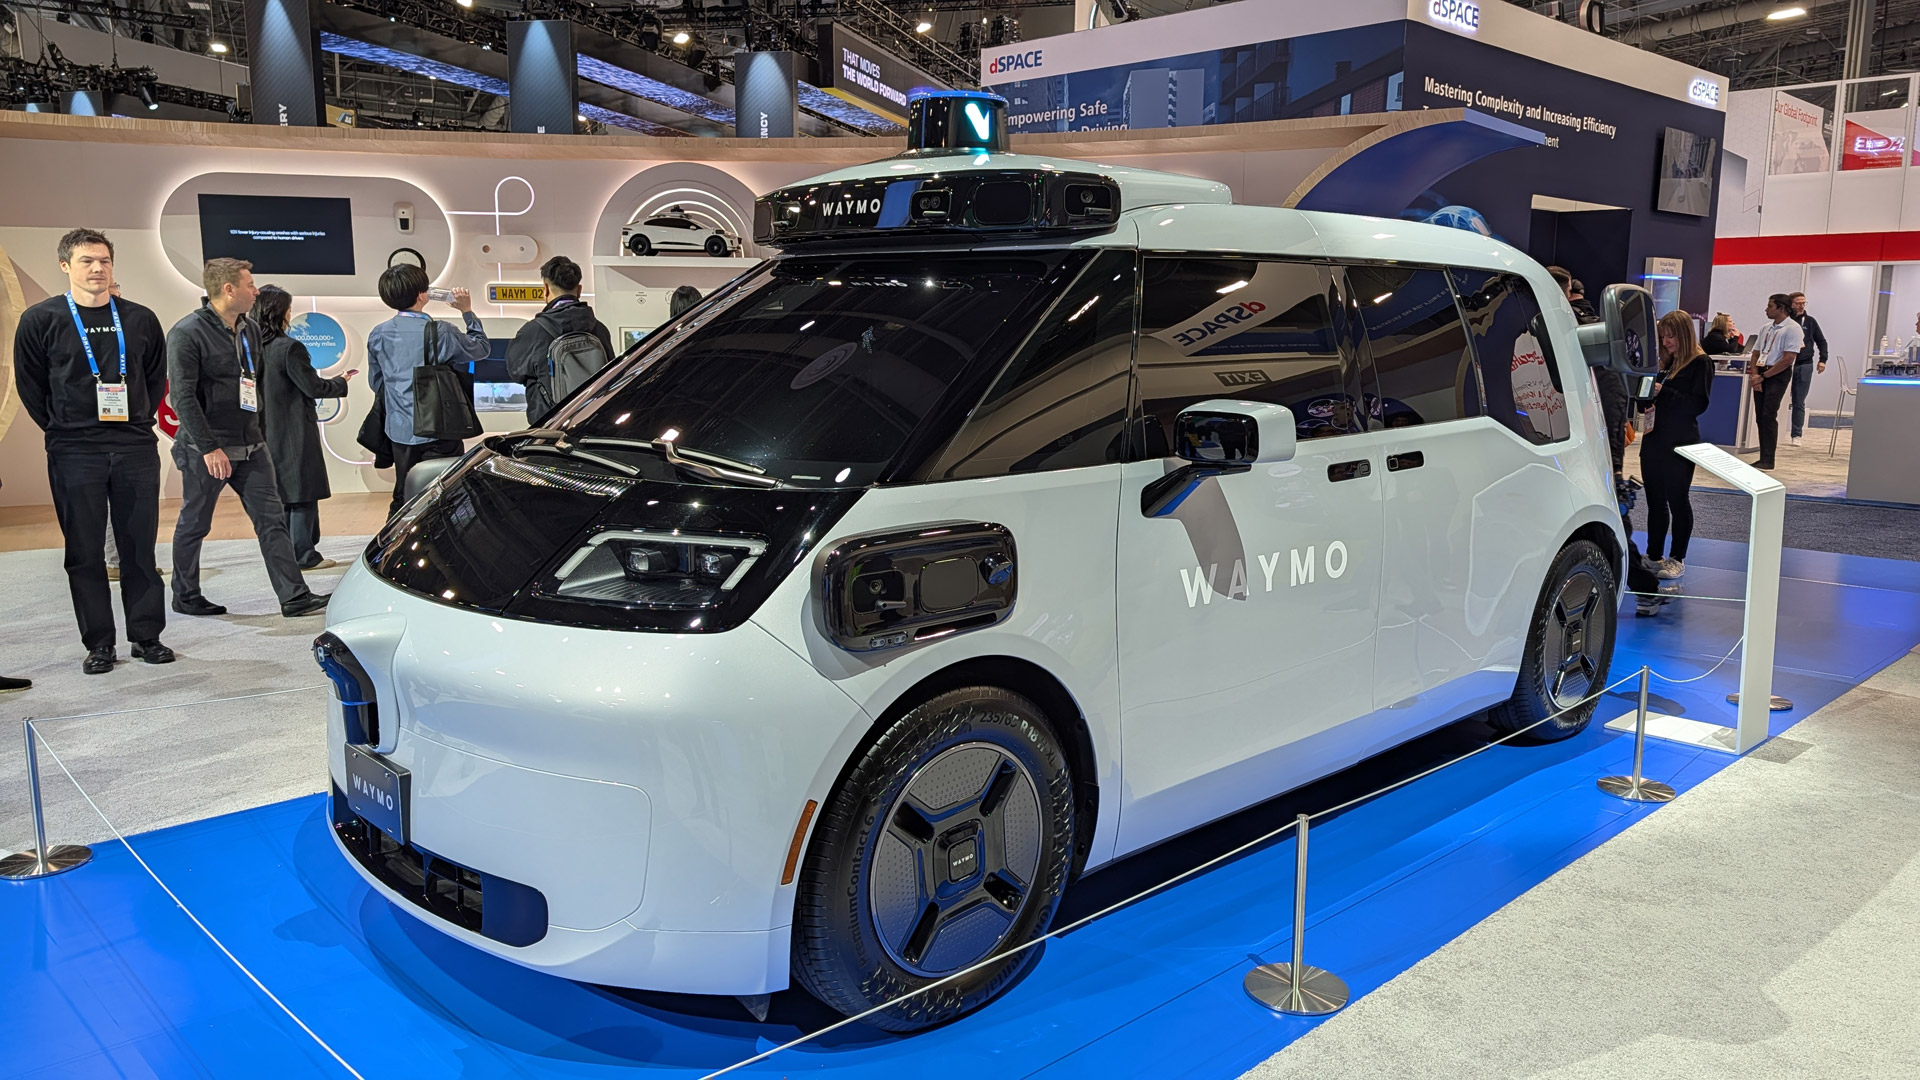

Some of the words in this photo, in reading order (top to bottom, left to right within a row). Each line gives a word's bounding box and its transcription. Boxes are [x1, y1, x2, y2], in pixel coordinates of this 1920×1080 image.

[1433, 0, 1480, 29] dSPACE
[842, 47, 860, 68] THAT
[860, 56, 881, 79] MOVES
[989, 50, 1043, 74] dSPACE
[842, 64, 856, 83] THE
[856, 71, 879, 93] WORLD
[879, 82, 907, 107] FORWARD
[1692, 80, 1719, 103] dSPACE
[1005, 105, 1076, 128] mpowering
[1080, 100, 1108, 117] Safe
[1424, 76, 1473, 107] Mastering
[1475, 90, 1525, 120] Complexity
[1525, 104, 1541, 120] and
[1543, 106, 1581, 132] Increasing
[1583, 116, 1617, 139] Efficiency
[1783, 102, 1798, 119] Global
[1798, 107, 1818, 128] Footprint
[822, 198, 881, 217] WAYMO
[501, 288, 527, 299] WAYM
[1179, 540, 1348, 608] WAYMO
[979, 711, 1019, 728] 235/65
[352, 772, 394, 811] WAYMO
[952, 853, 974, 867] WAYMO
[846, 828, 870, 968] PremiumContact
[863, 813, 875, 827] 6
